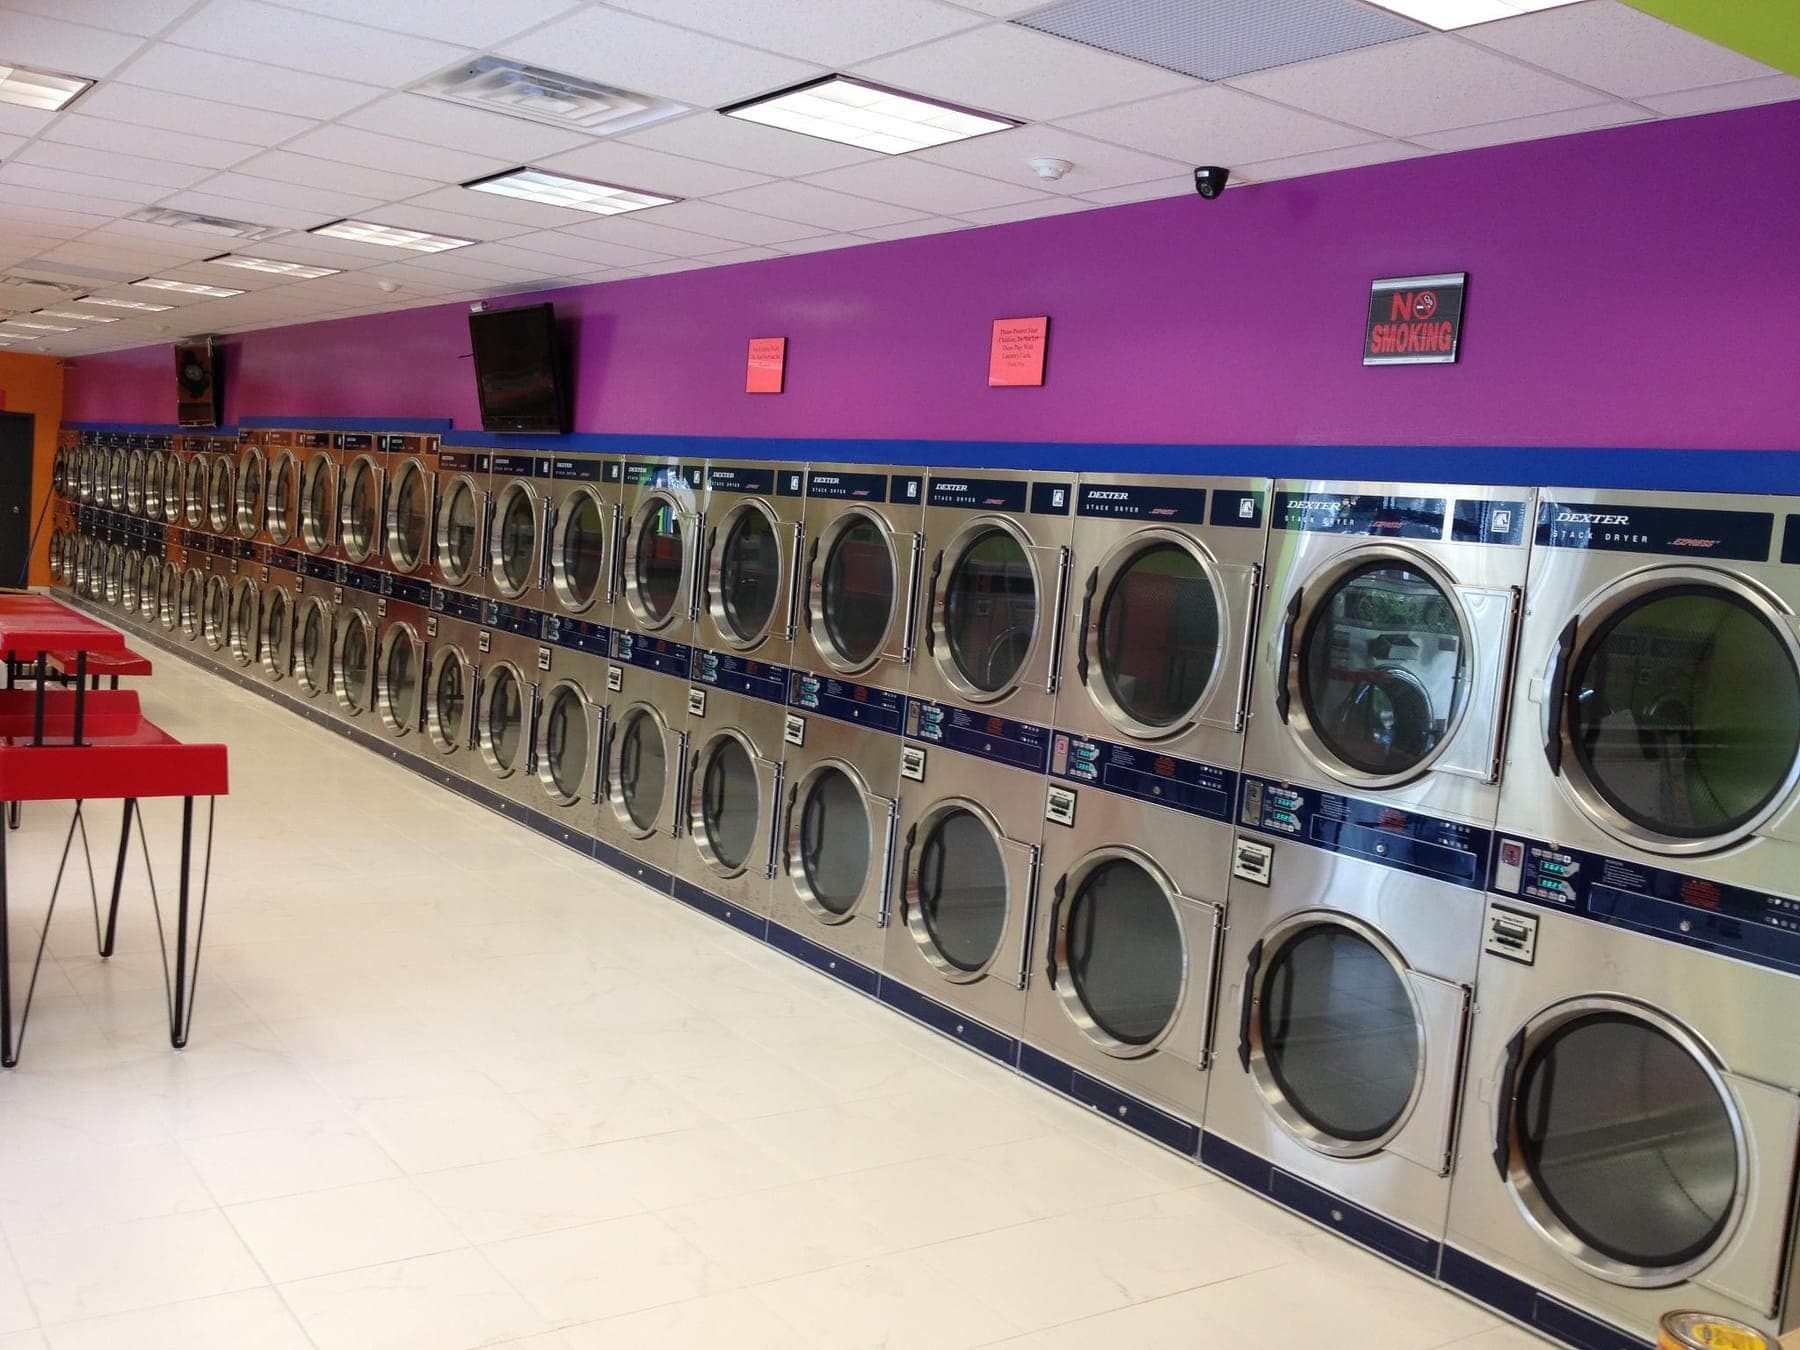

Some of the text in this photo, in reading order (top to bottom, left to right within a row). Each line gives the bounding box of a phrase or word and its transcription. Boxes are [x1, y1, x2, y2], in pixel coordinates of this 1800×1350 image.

[1371, 321, 1452, 353] SMOKING
[713, 471, 735, 479] DEXTER
[813, 476, 840, 485] DEXTER
[935, 483, 968, 492] DEXTER
[1087, 490, 1129, 500] DEXTER
[1086, 503, 1109, 511] STACK
[1114, 505, 1139, 513] DRYER
[1286, 500, 1341, 510] DEXTER
[1556, 512, 1630, 526] DEXTER
[1552, 530, 1593, 540] STACK
[1604, 532, 1649, 544] DRYER
